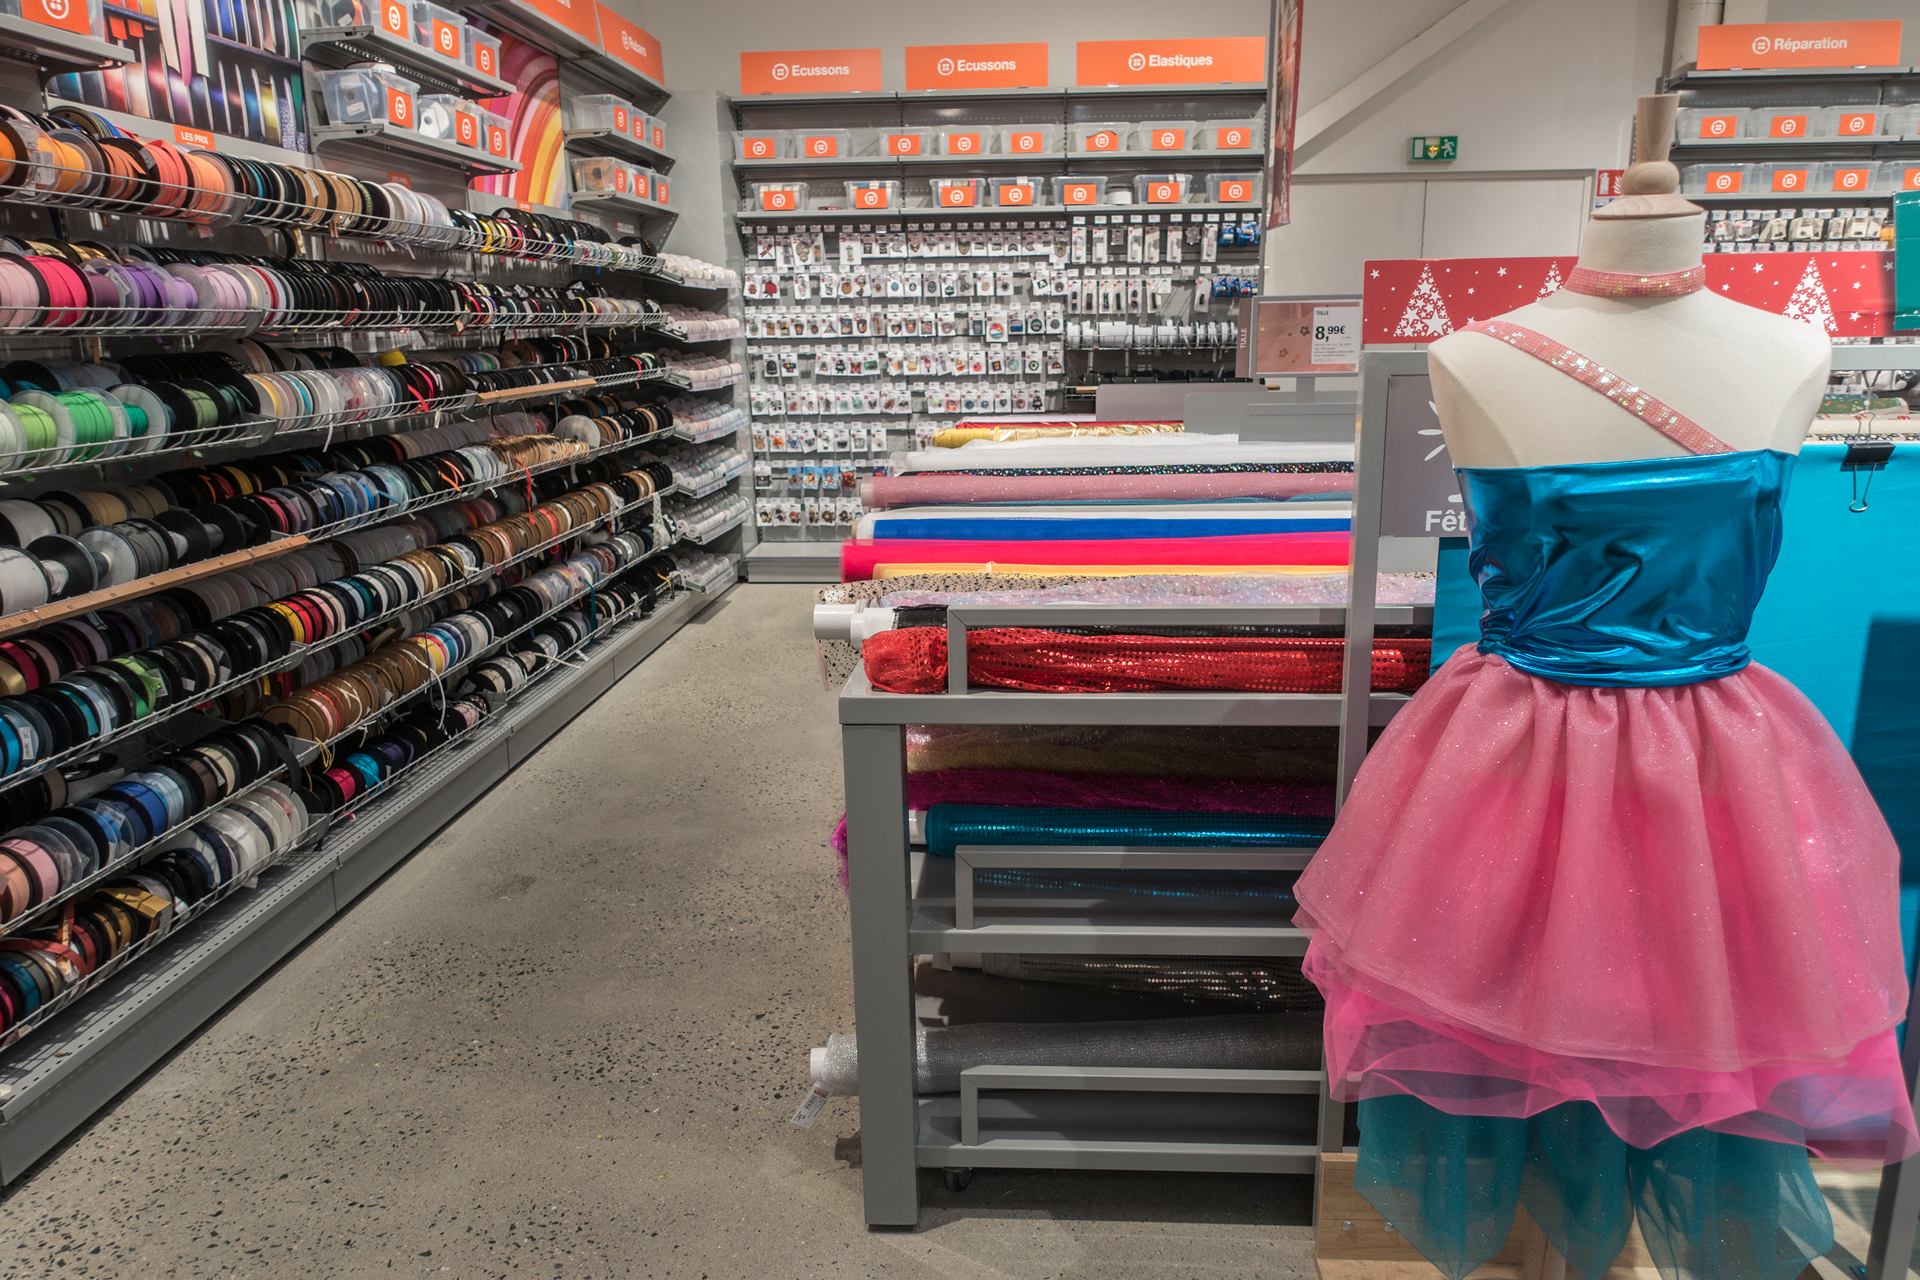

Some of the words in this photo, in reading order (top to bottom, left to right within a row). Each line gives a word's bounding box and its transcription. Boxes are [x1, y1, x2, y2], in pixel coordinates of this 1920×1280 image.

[1774, 37, 1848, 53] Réparation
[957, 59, 1017, 72] Ecussons
[1148, 54, 1214, 69] Elastiques
[791, 64, 850, 77] Ecussons
[180, 131, 194, 142] LES
[1240, 327, 1248, 349] TULLE
[1315, 325, 1346, 342] 8,99€
